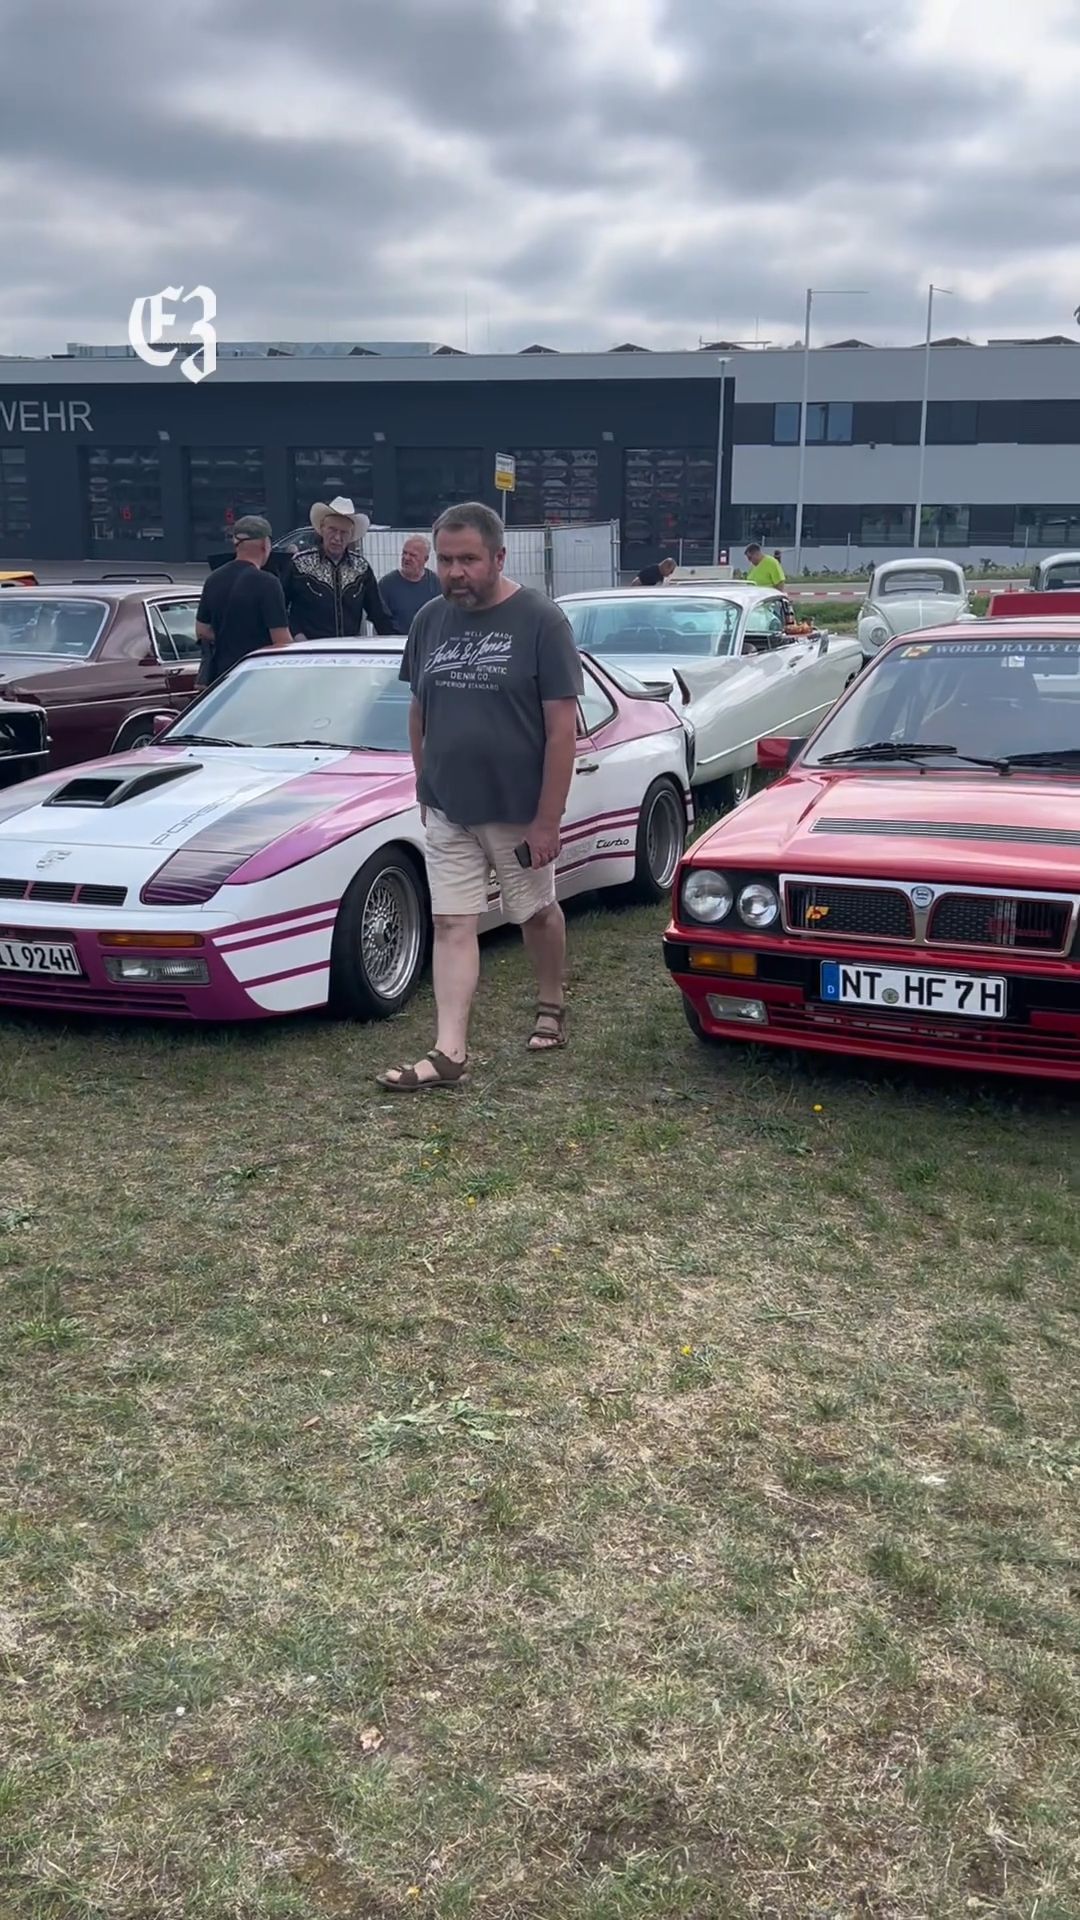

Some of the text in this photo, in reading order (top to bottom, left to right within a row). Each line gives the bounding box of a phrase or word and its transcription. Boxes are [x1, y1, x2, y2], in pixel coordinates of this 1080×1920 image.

[459, 642, 473, 660] &
[936, 643, 996, 654] WORLD
[1001, 643, 1061, 653] RALLY
[359, 657, 401, 666] MAR
[450, 671, 476, 680] DENIM
[435, 680, 466, 689] SUPERIOR
[596, 837, 630, 849] Turbo
[21, 946, 76, 971] 924H
[827, 985, 835, 994] D
[842, 969, 882, 1000] NT
[904, 976, 947, 1006] HF
